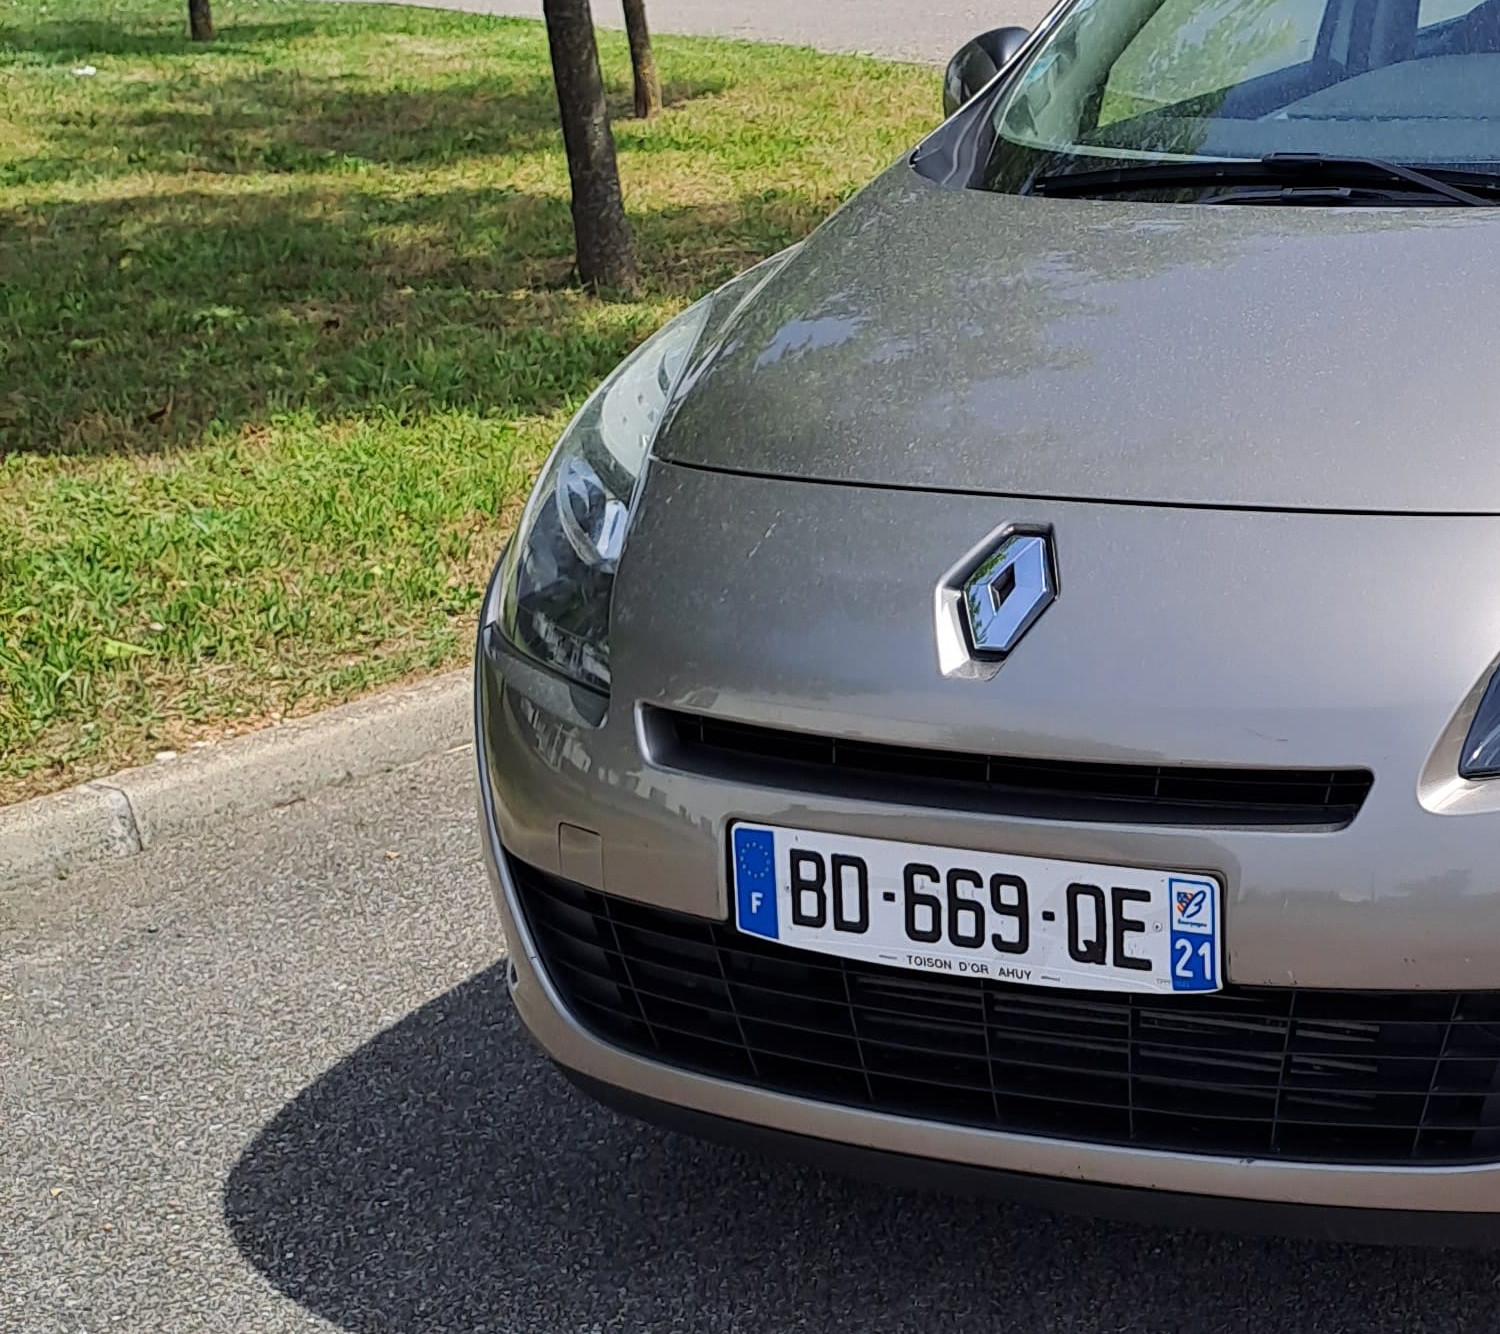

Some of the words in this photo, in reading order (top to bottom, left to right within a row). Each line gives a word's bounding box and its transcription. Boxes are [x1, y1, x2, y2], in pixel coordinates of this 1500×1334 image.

[751, 891, 764, 914] F
[789, 848, 1152, 972] BD-669-QE
[906, 955, 952, 970] TOISON
[958, 961, 990, 975] D'OR
[998, 966, 1032, 980] AHUY
[1175, 938, 1211, 980] 21
